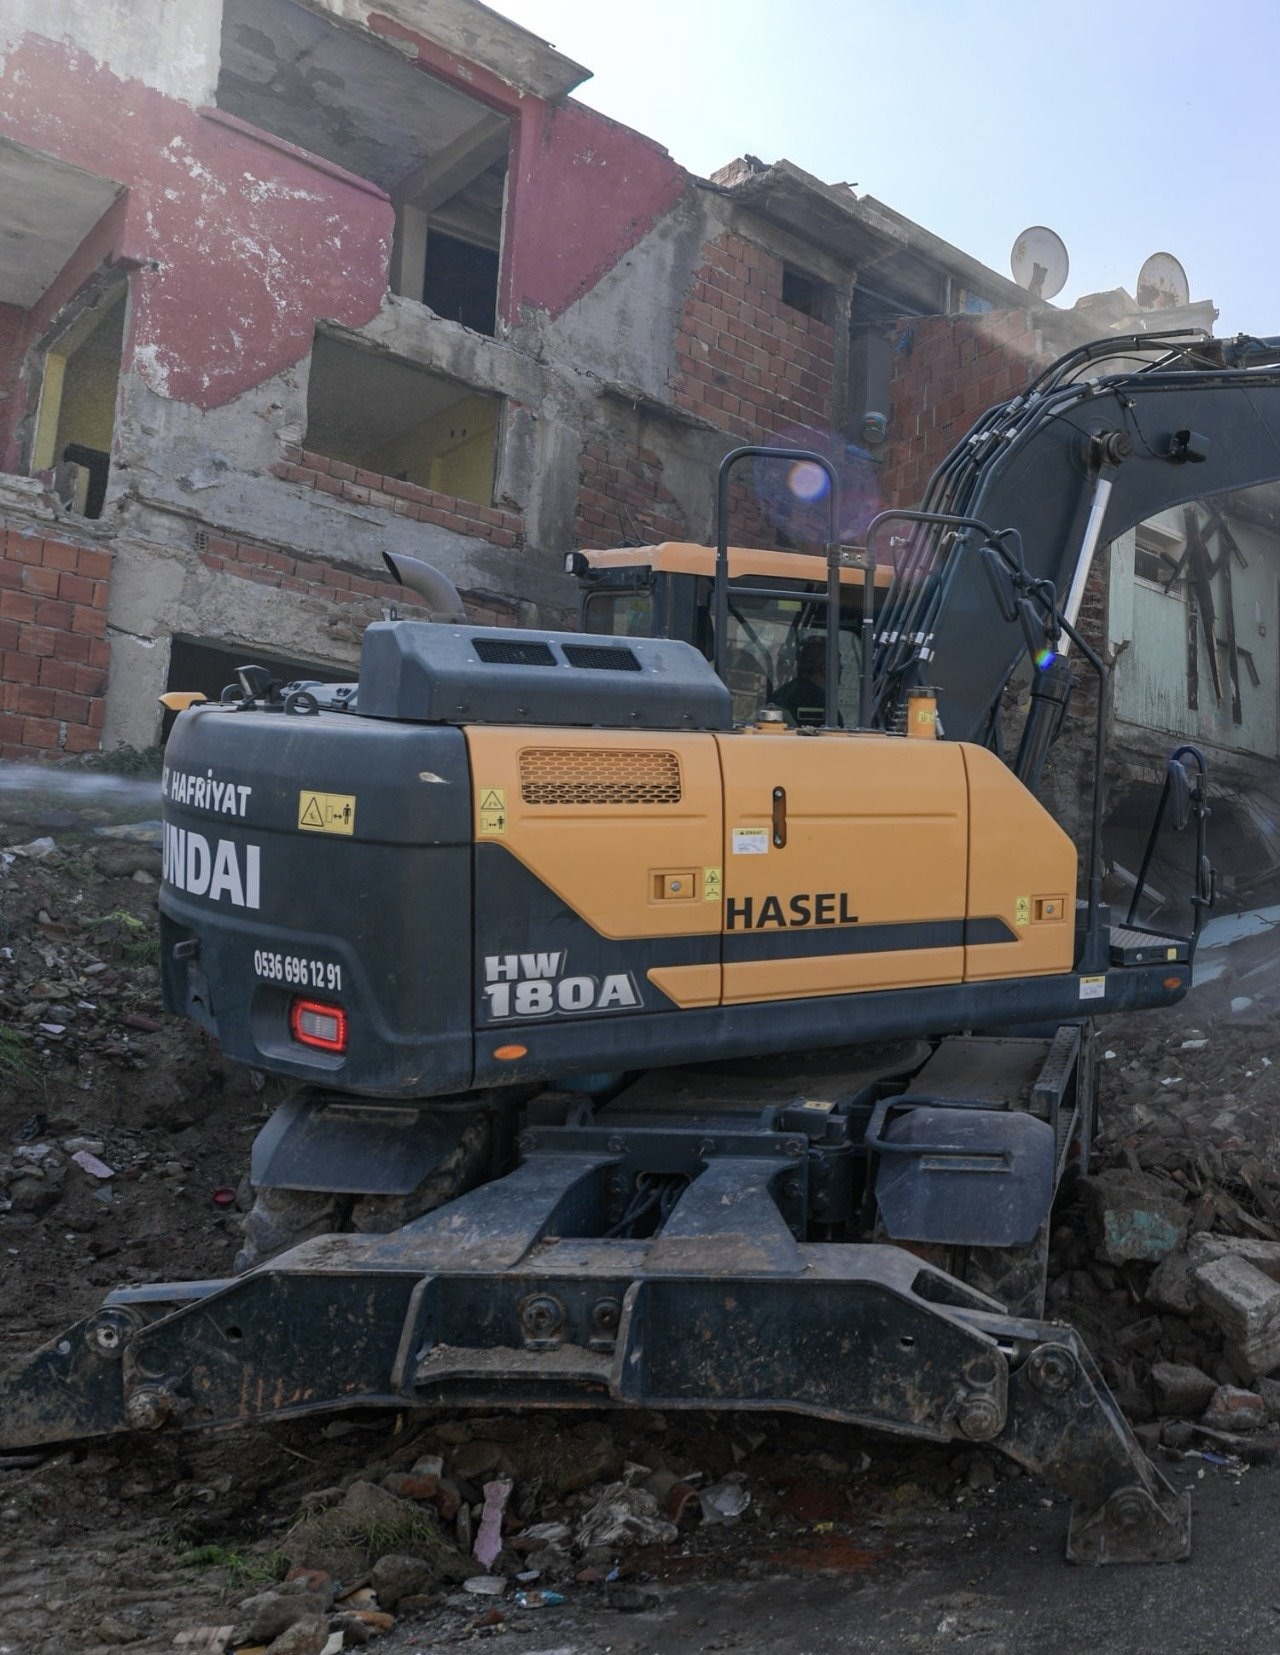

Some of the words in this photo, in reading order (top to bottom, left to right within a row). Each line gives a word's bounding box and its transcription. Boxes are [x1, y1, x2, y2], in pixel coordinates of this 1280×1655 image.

[171, 769, 252, 817] HAFRİYAT
[726, 892, 859, 930] HASEL
[254, 949, 283, 980] 0536
[285, 956, 308, 985] 696
[310, 960, 325, 987] 12
[327, 963, 342, 991] 91
[485, 952, 562, 981] HW
[484, 974, 637, 1017] 180A
